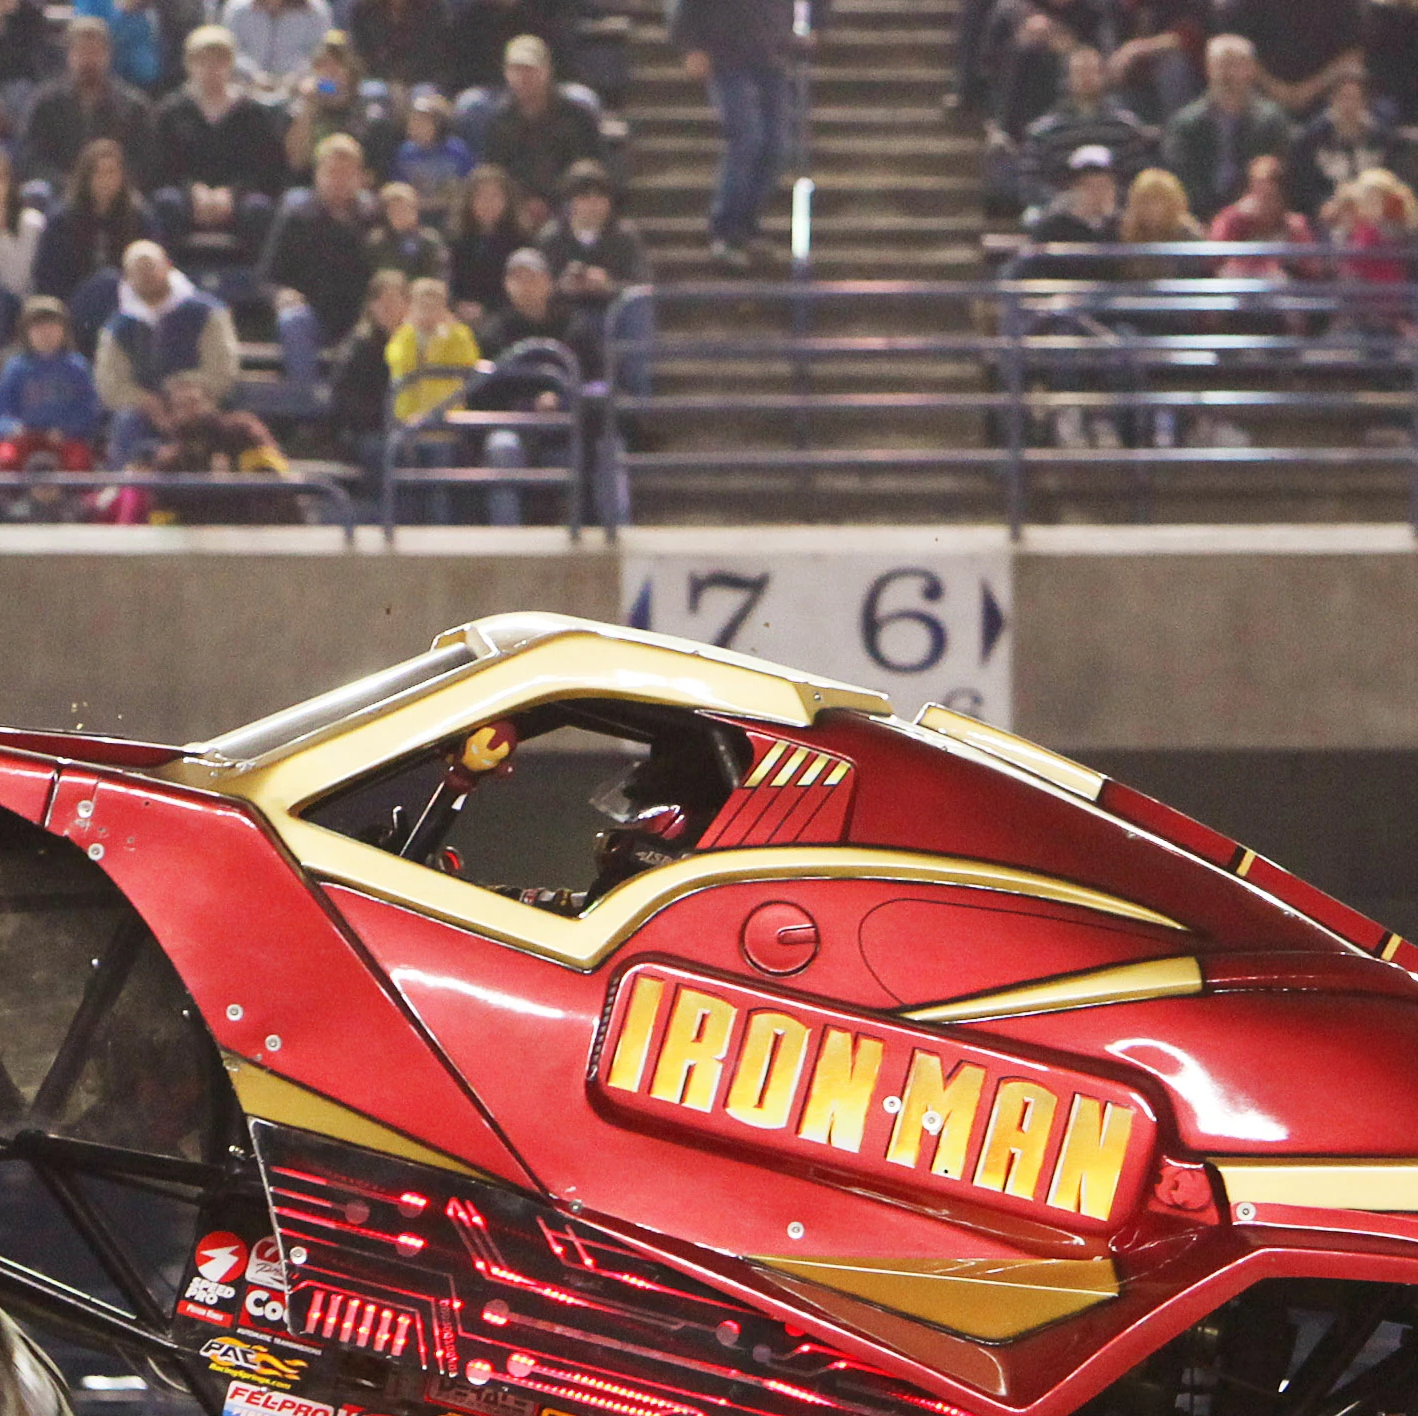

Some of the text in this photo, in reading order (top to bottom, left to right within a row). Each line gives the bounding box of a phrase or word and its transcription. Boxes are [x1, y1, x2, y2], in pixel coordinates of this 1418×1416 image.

[688, 567, 947, 673] 7 6
[608, 975, 1135, 1221] IRON MAN
[185, 1286, 218, 1305] PRO
[190, 1276, 236, 1299] SPEED
[245, 1290, 288, 1324] Co
[199, 1339, 262, 1371] PAC
